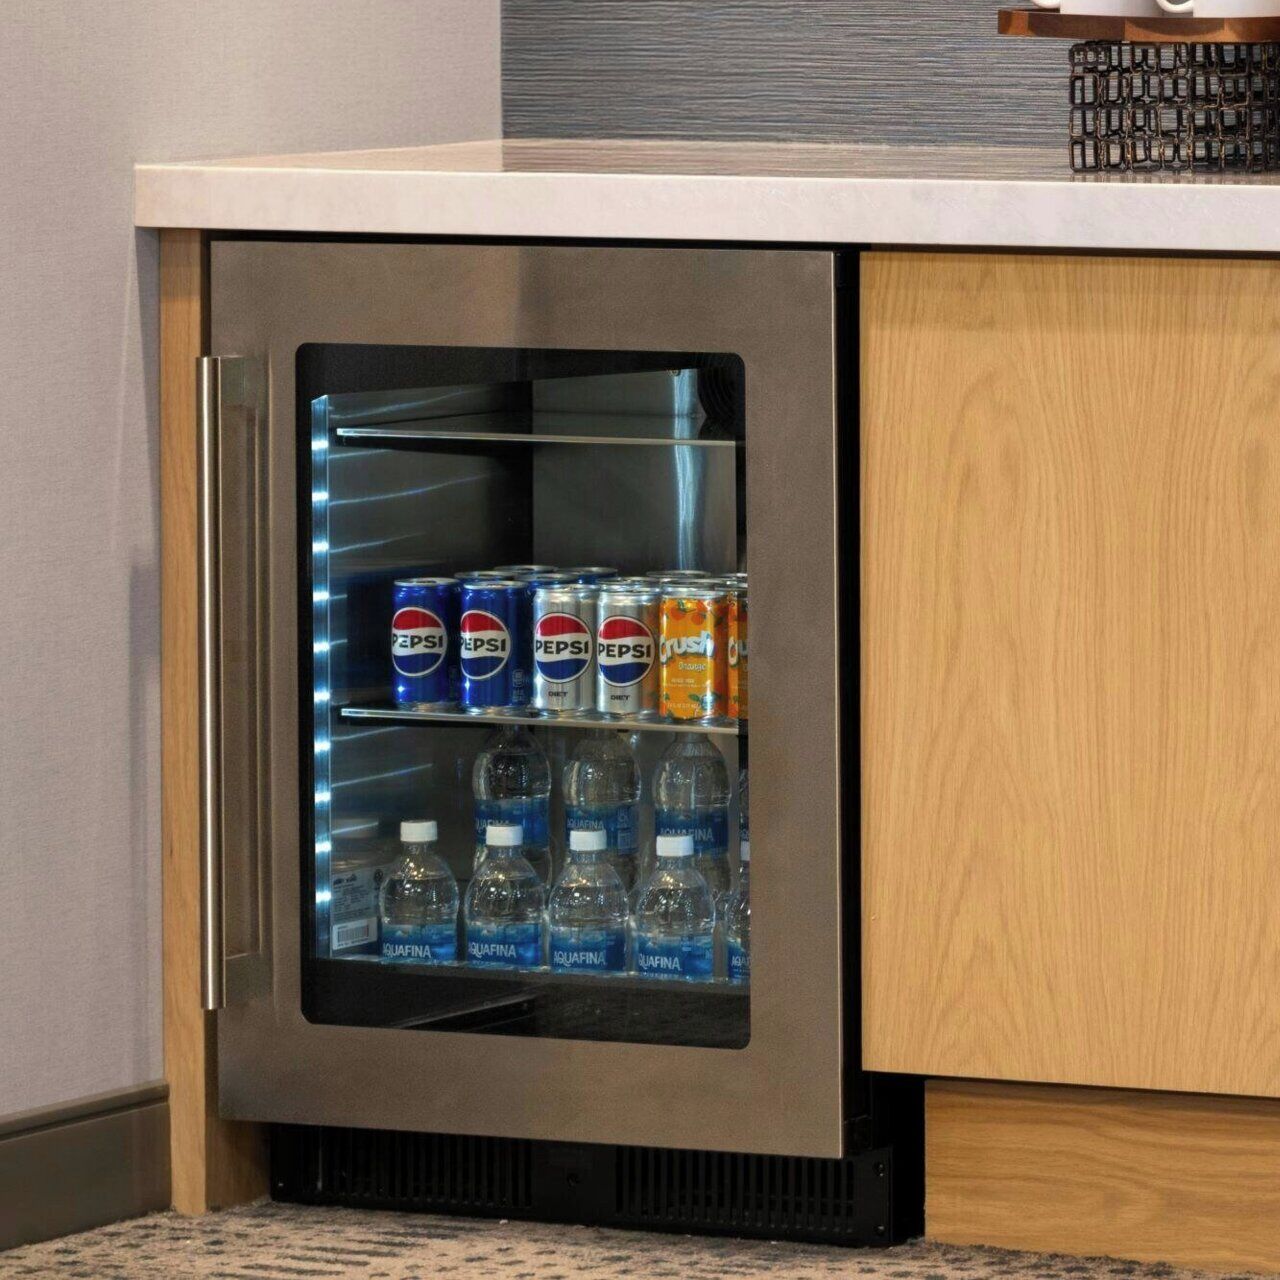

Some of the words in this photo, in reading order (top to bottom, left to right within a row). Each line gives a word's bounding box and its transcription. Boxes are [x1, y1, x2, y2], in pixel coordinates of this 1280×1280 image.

[392, 634, 443, 649] PEPSI
[461, 637, 506, 652] PEPSI
[535, 640, 589, 655] PEPSI
[659, 630, 715, 664] Crush
[598, 643, 651, 658] PEPSI
[383, 942, 432, 959] AQUAFINA
[468, 941, 517, 959] AQUAFINA
[553, 950, 607, 967] AQUAFINA
